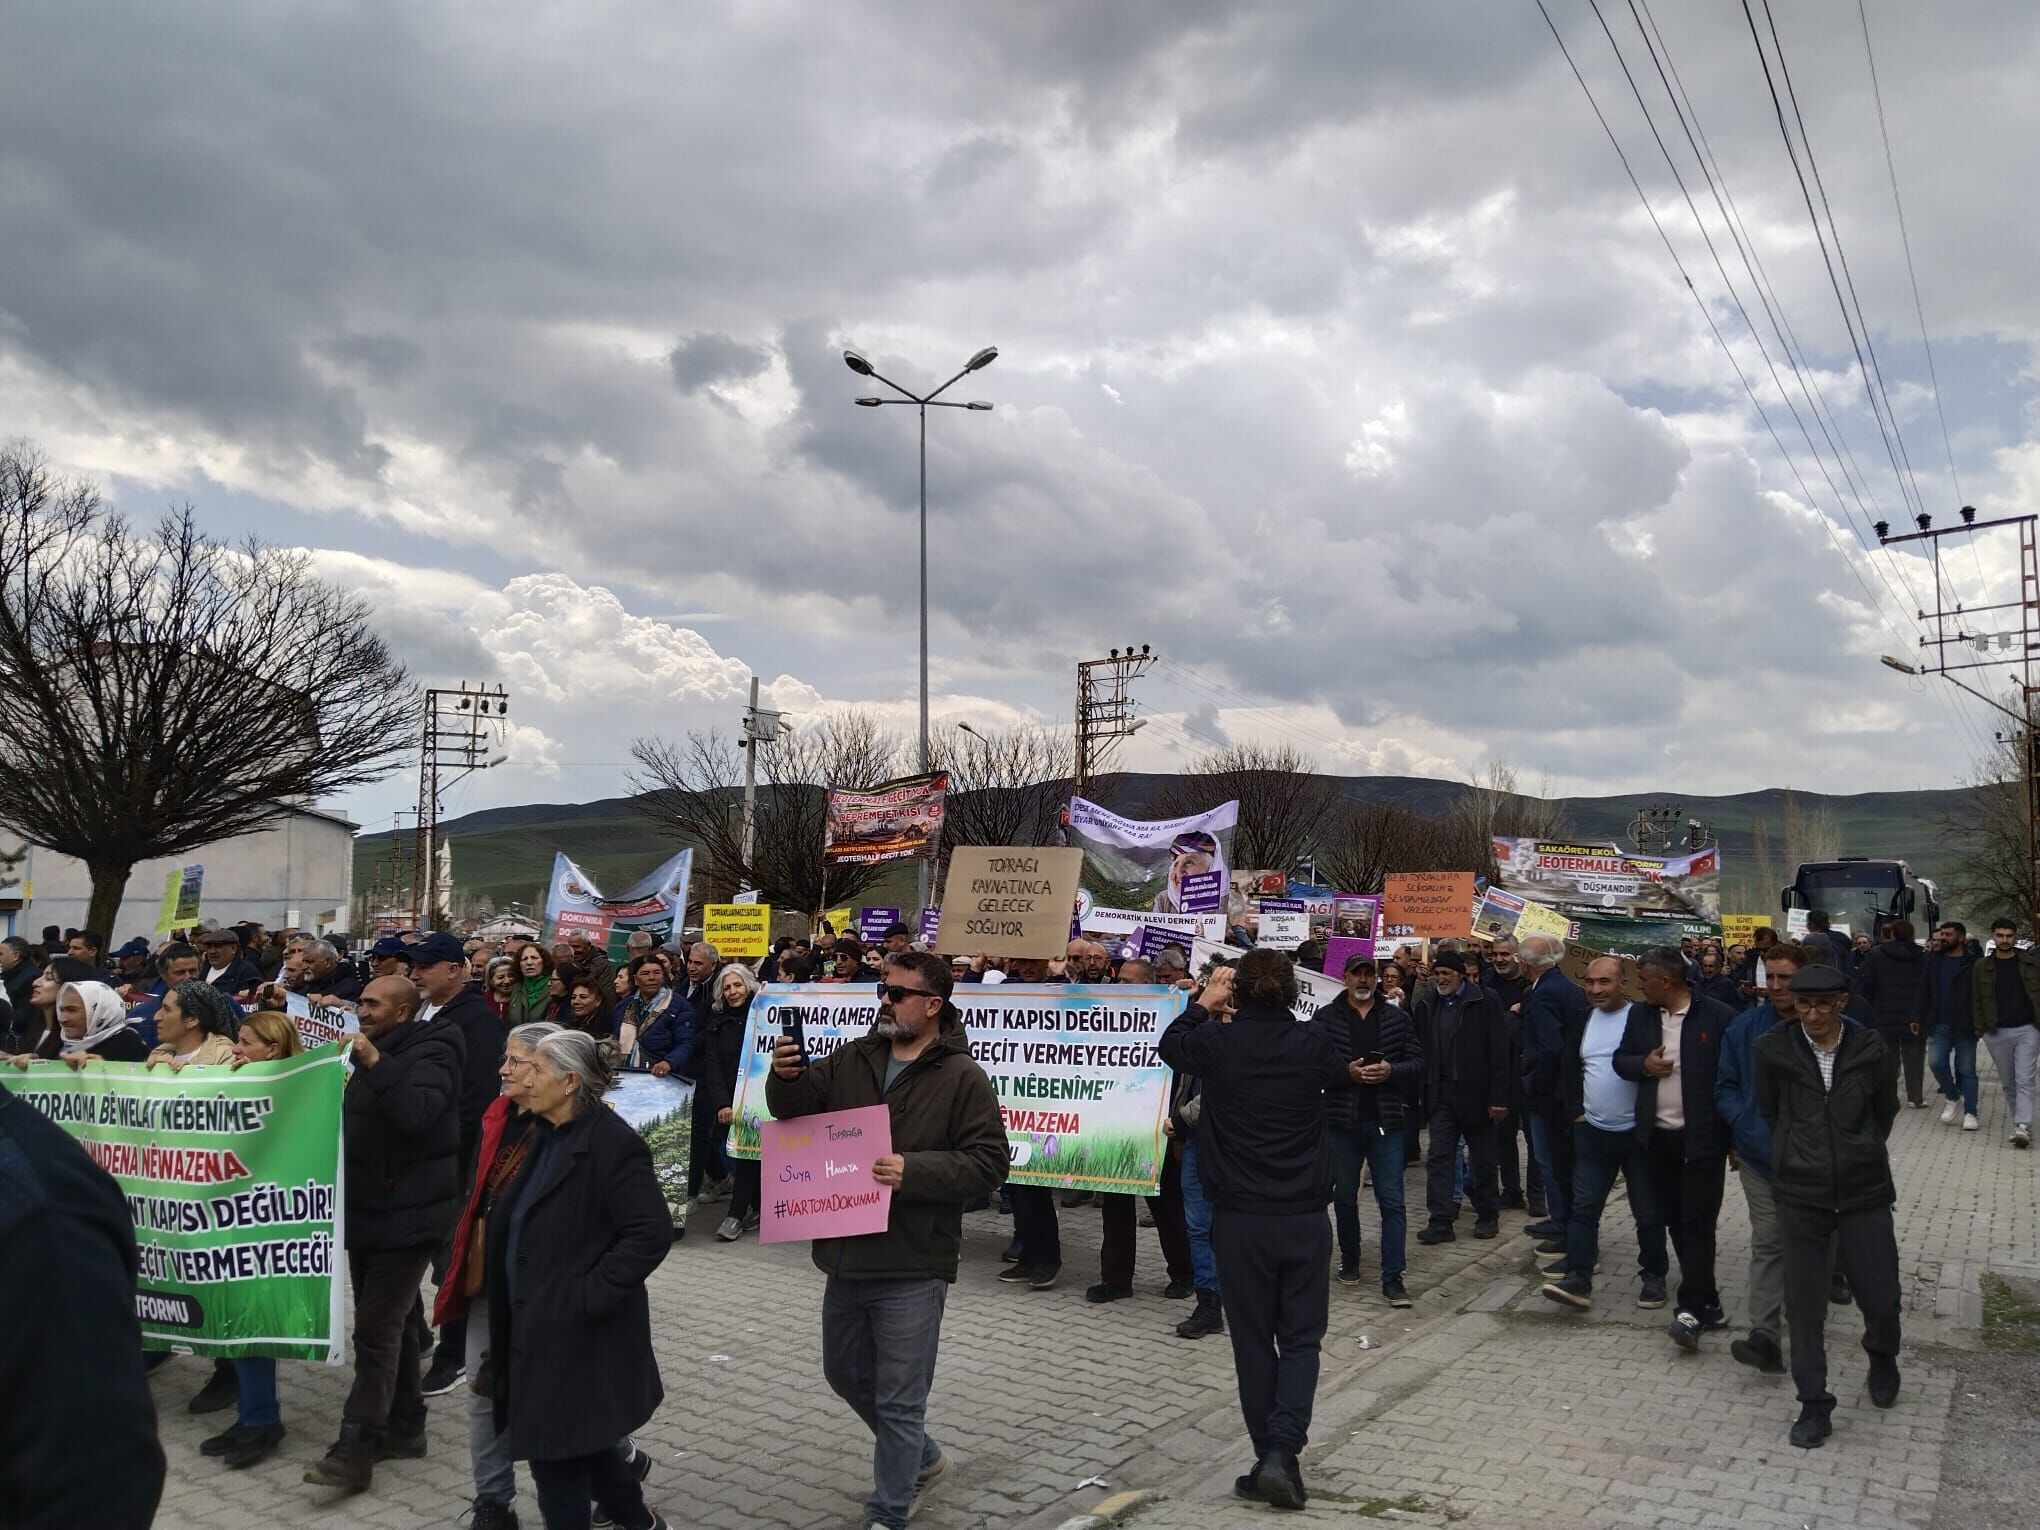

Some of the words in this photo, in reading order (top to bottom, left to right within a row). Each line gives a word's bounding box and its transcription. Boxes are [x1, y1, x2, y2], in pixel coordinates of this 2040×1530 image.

[1535, 855, 1619, 873] JEOTERMALE
[1592, 848, 1617, 857] EKOL
[977, 898, 1035, 912] GELECEK
[561, 913, 603, 926] DOKUNMA
[965, 918, 1024, 937] SOĞUYOR
[1168, 917, 1217, 926] DERNEERİ
[308, 1003, 345, 1029] VARTO
[767, 1006, 829, 1026] ONAR
[1003, 1009, 1060, 1030] KAPISI
[1065, 1006, 1156, 1033] DEĞİLDİR!
[970, 1037, 1019, 1065] GEÇİT
[1024, 1041, 1162, 1068] VERMEYECEĞİZ.
[99, 1090, 116, 1125] BÊ
[117, 1096, 160, 1129] WELAT
[999, 1105, 1080, 1134] ÊWAZENA
[141, 1142, 250, 1182] NÊWAZENA
[148, 1197, 209, 1232] KAPISI
[213, 1180, 333, 1229] DEĞİLDİR!
[137, 1240, 168, 1282] EÇİT
[136, 1294, 189, 1324] TFORMU
